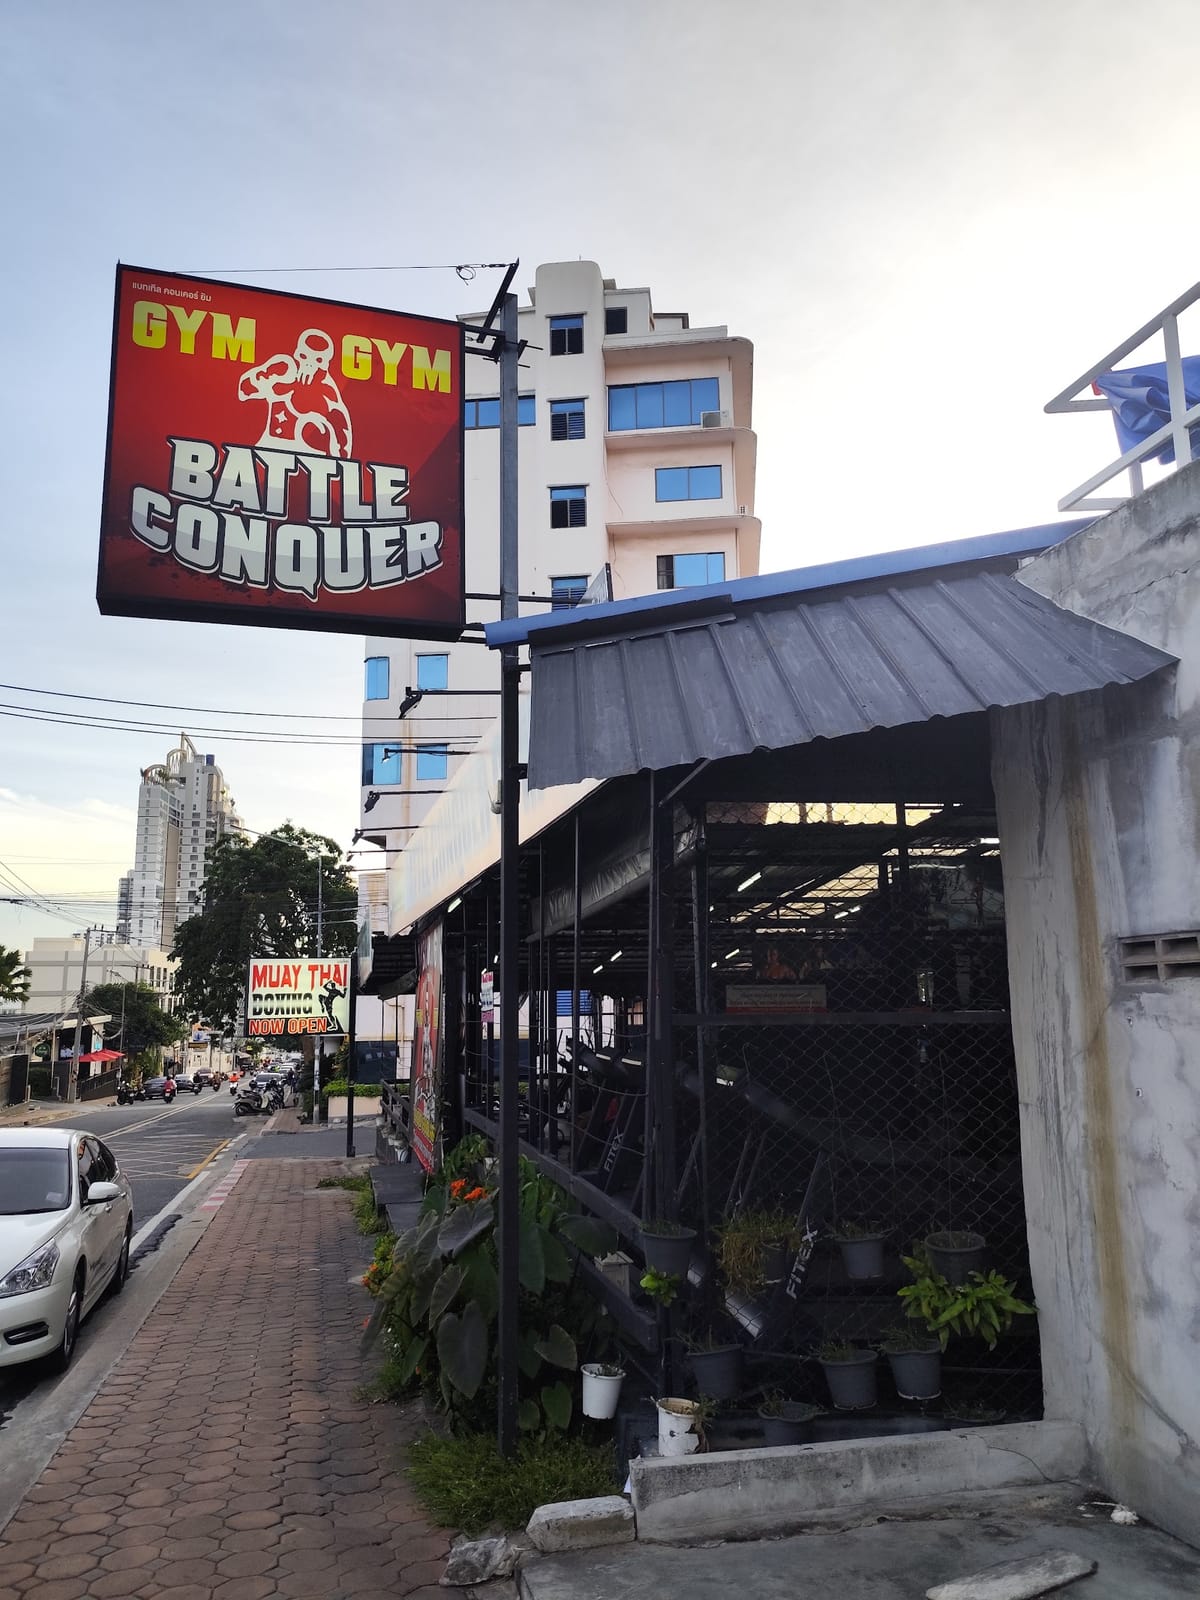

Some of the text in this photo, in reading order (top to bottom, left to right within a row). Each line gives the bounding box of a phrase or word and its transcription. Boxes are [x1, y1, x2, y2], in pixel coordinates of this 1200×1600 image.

[132, 301, 256, 364] GYM
[341, 334, 452, 394] GYM
[167, 436, 410, 524] BATTLE
[130, 485, 443, 602] CONQUER
[252, 964, 348, 992] MUAY THAI
[252, 993, 313, 1016] BOXING
[249, 1017, 328, 1036] NOW OPEN
